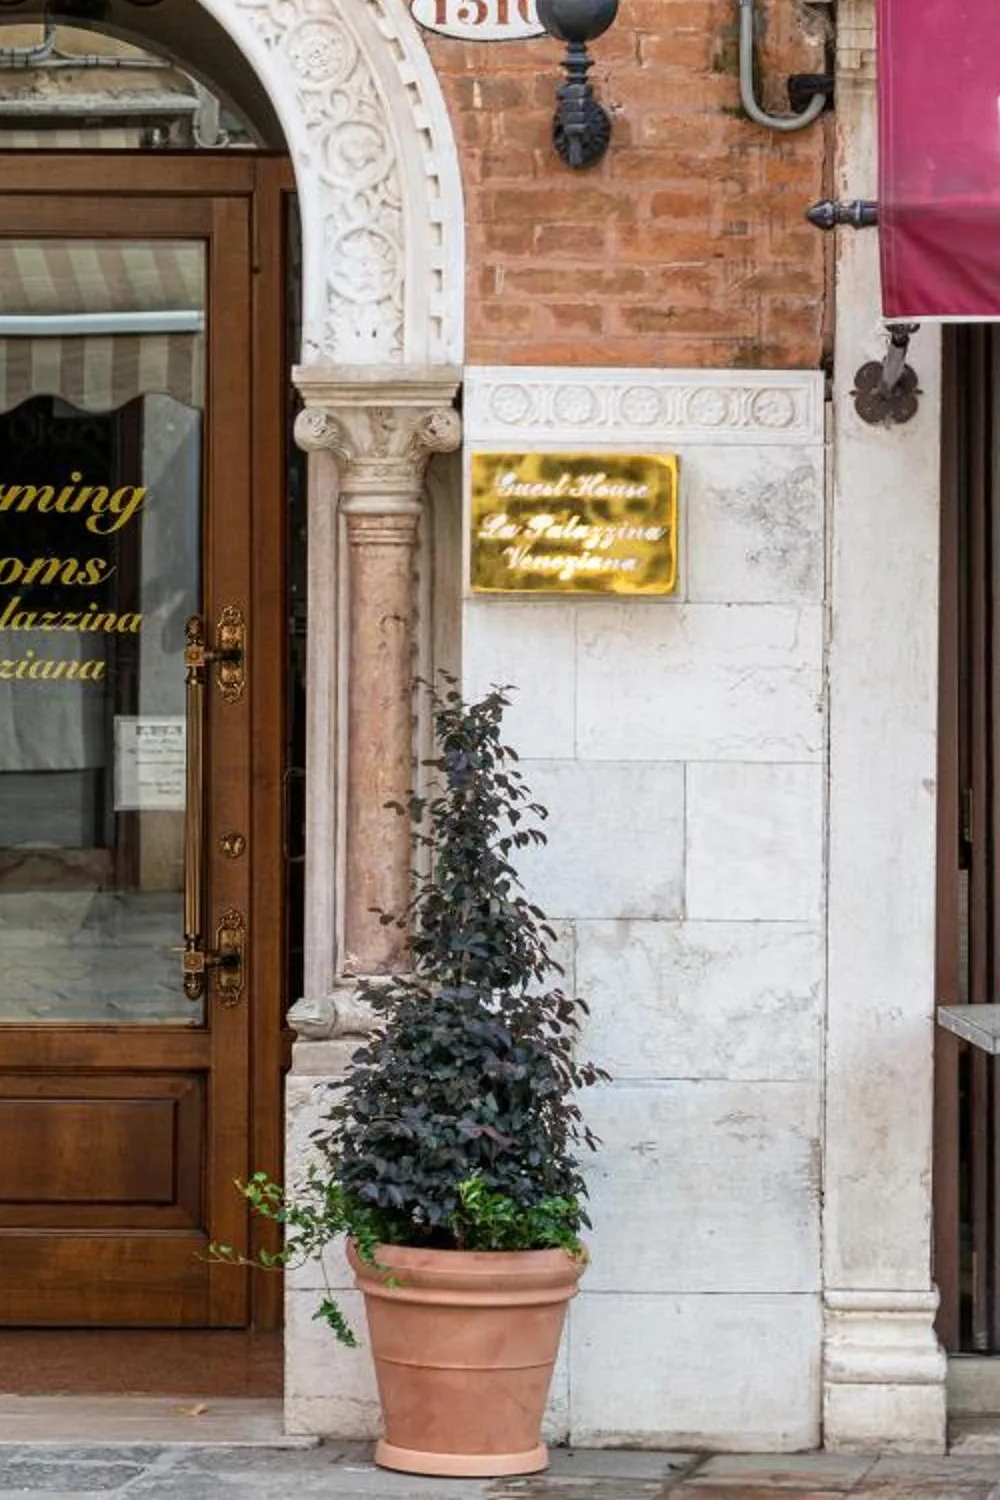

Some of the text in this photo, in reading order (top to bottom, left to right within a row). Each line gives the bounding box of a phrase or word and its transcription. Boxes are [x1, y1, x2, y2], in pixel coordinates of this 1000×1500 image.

[496, 471, 650, 498] Guest House
[478, 513, 667, 550] La Palazzina
[503, 546, 637, 581] Veneziana
